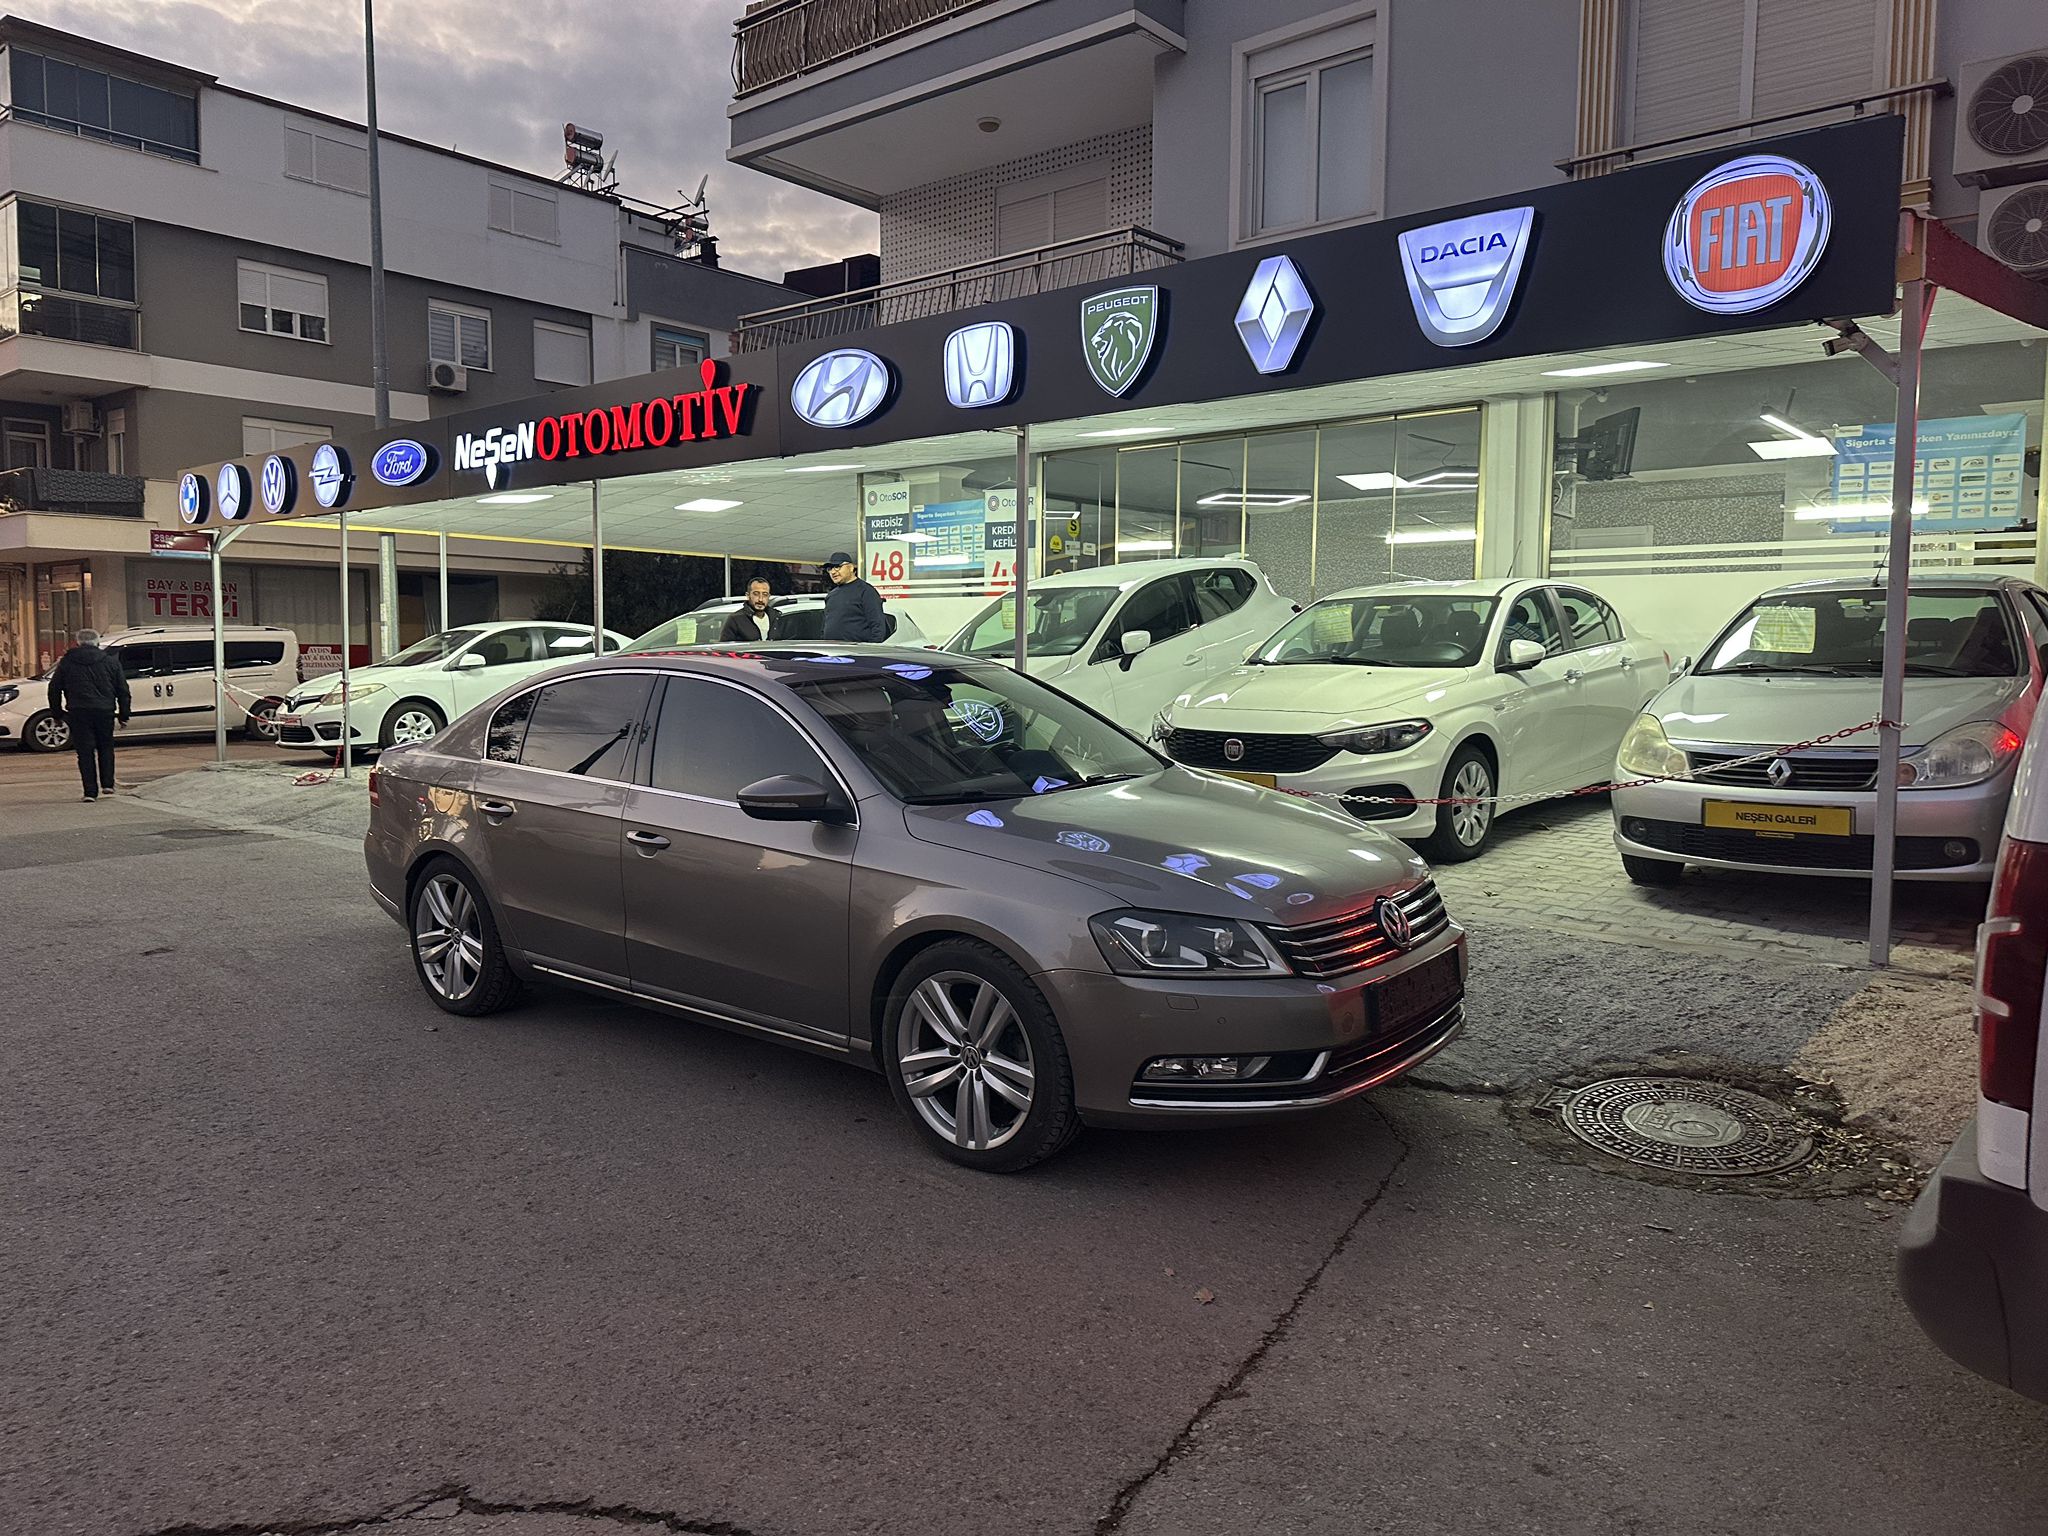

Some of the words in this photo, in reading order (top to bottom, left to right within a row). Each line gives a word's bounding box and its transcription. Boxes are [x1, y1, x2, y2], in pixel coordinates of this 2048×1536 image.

[1697, 195, 1792, 273] FIAT
[1420, 232, 1508, 264] DACIA
[1087, 295, 1149, 315] PEUGEOT
[536, 358, 748, 461] OTOMOTİV
[1845, 438, 1886, 448] Sigorta
[1888, 434, 1943, 445] Srken
[383, 449, 413, 477] Ford
[879, 491, 908, 502] OtoSOR
[1001, 496, 1034, 508] OtoR
[871, 516, 904, 528] KREDİSİZ
[1070, 519, 1077, 531] S
[871, 551, 904, 581] 48
[147, 579, 174, 590] BAY
[180, 580, 189, 591] &
[194, 581, 237, 593] BAAN
[1735, 812, 1773, 824] NEŞEN
[1775, 814, 1817, 826] GALERİ
